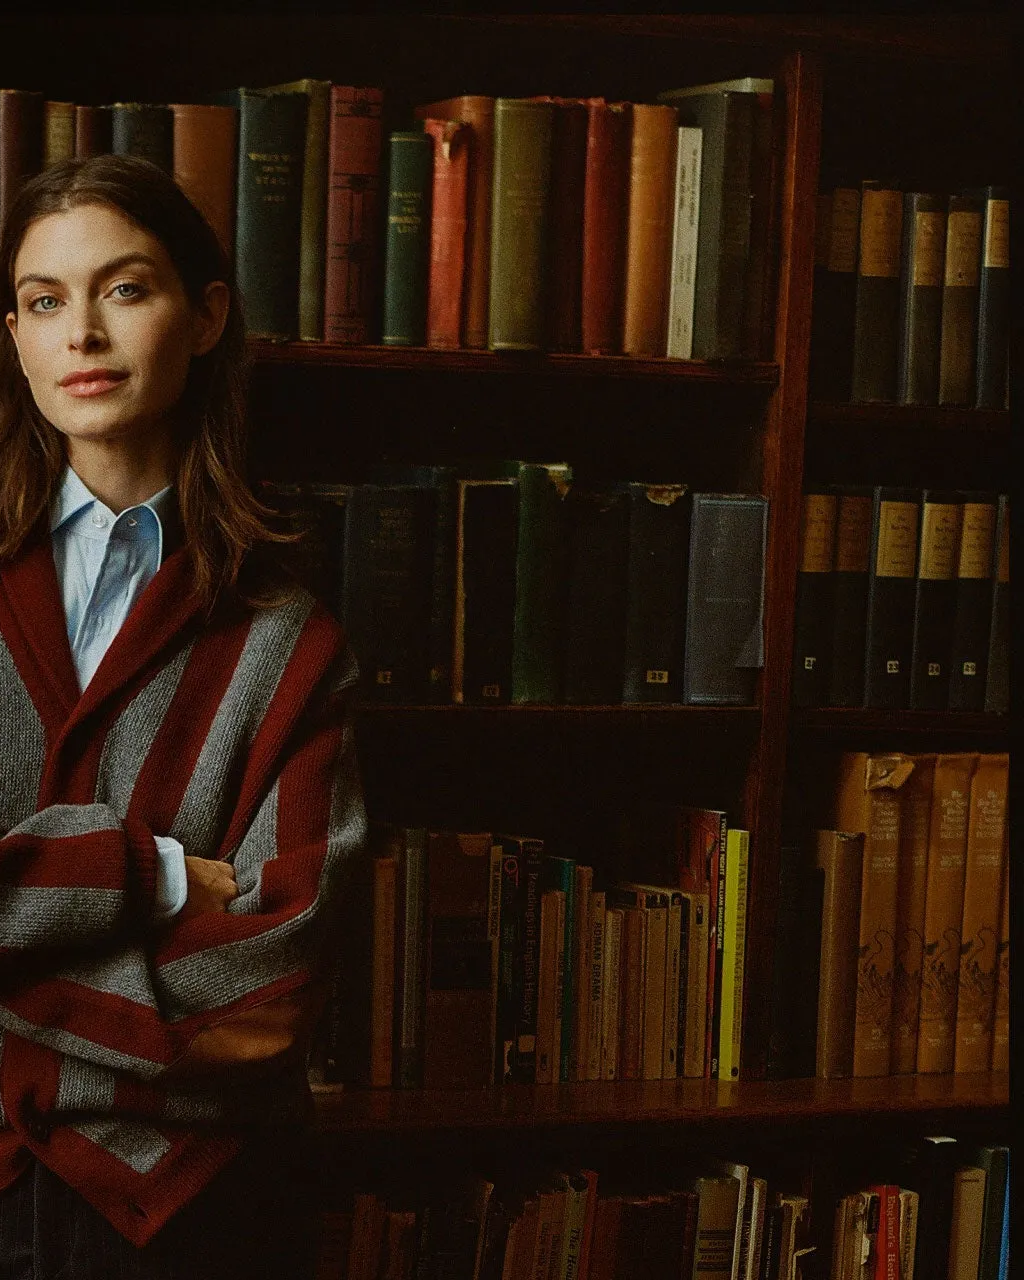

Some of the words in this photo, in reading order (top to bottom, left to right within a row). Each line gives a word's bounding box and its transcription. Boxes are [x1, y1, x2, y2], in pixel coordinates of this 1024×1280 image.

[526, 872, 537, 924] Readings
[738, 862, 746, 912] TAKING
[526, 925, 532, 936] in
[594, 922, 602, 960] ROMAN
[736, 916, 744, 940] THE
[524, 940, 536, 979] English
[734, 942, 742, 982] STAGE
[522, 982, 535, 1024] History
[570, 1228, 580, 1250] The
[884, 1195, 894, 1248] England's
